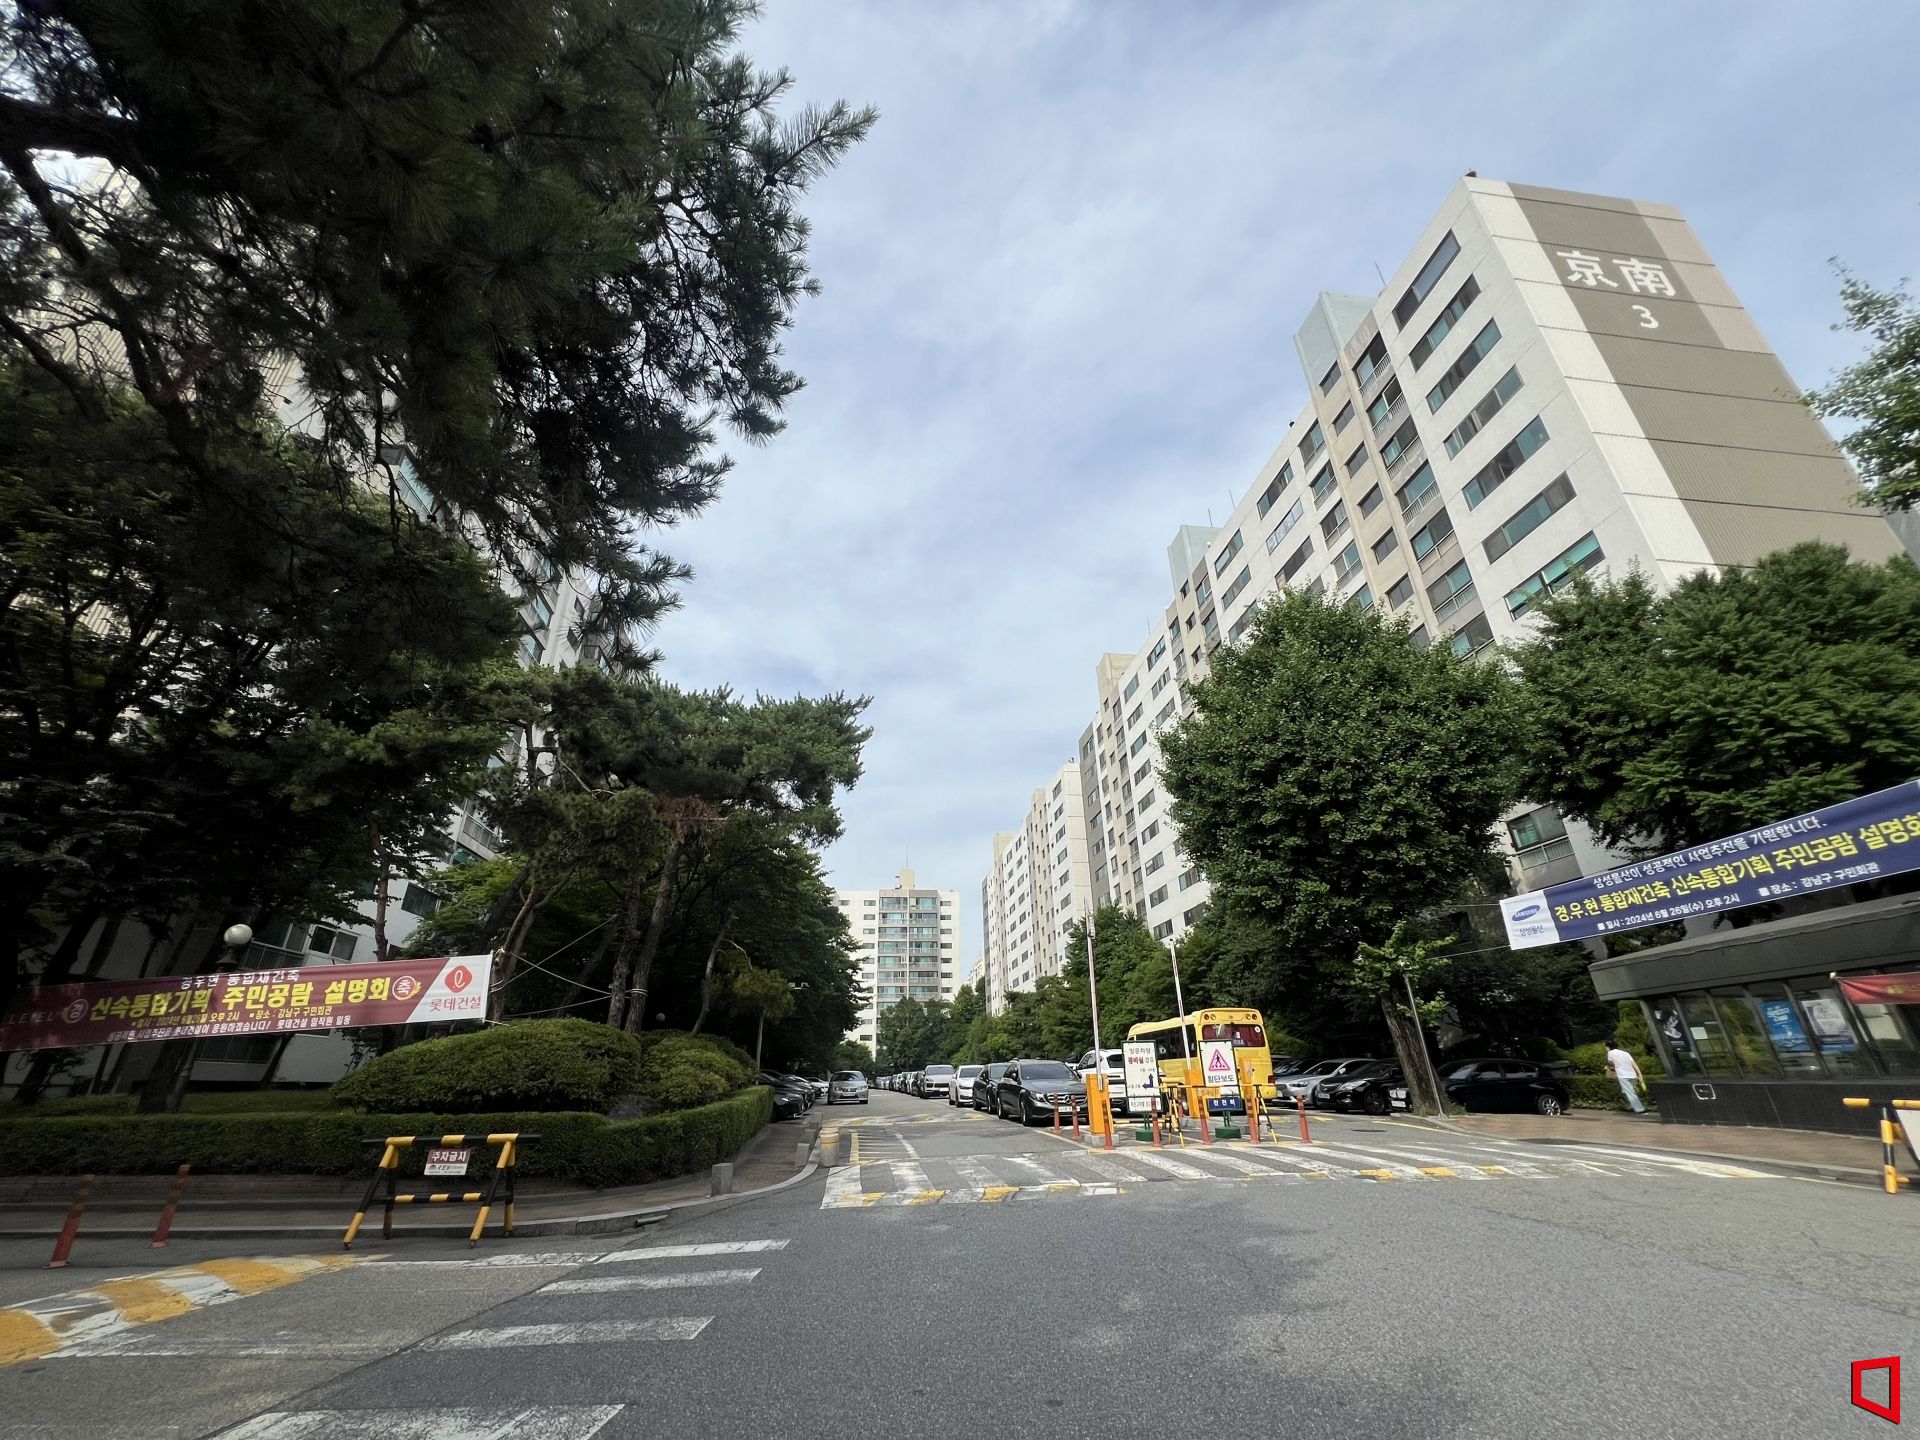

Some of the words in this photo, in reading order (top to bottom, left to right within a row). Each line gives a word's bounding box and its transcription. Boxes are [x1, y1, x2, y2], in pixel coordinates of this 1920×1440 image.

[1556, 250, 1676, 296] 京南
[1632, 304, 1659, 329] 3
[1594, 867, 1642, 888] 삼성물산이
[1642, 854, 1688, 876] 성공적인
[1689, 837, 1750, 866] 사업추진을
[1750, 815, 1828, 846] 기원합니다.
[1555, 896, 1600, 923] 경.우.현
[1600, 881, 1672, 914] 통합재건축
[1672, 853, 1775, 897] 신속통합기획
[1772, 832, 1859, 871] 주민공람
[1625, 910, 1654, 925] 2024년
[1655, 907, 1669, 919] 6월
[1670, 900, 1705, 917] 26일(수)
[1705, 896, 1724, 909] 오후
[1725, 893, 1741, 905] 2시
[1799, 872, 1834, 889] 강남구
[1833, 861, 1881, 881] 구민회관
[397, 979, 411, 995] 축
[89, 987, 213, 1022] 신속통합기획
[221, 980, 313, 1011] 주민공람
[325, 977, 391, 1005] 설명회
[429, 996, 482, 1012] 롯데건설
[210, 1013, 225, 1022] 오후
[227, 1011, 240, 1021] 2시
[277, 1006, 301, 1019] 강남구
[302, 1005, 333, 1017] 구민회관
[211, 1020, 270, 1035] 응원하겠습니다!
[277, 1016, 307, 1030] 롯데건설
[310, 1016, 333, 1028] 임직원
[336, 1014, 352, 1026] 일동
[1208, 1074, 1235, 1083] 횡단보도
[431, 1151, 467, 1162] 주차금지
